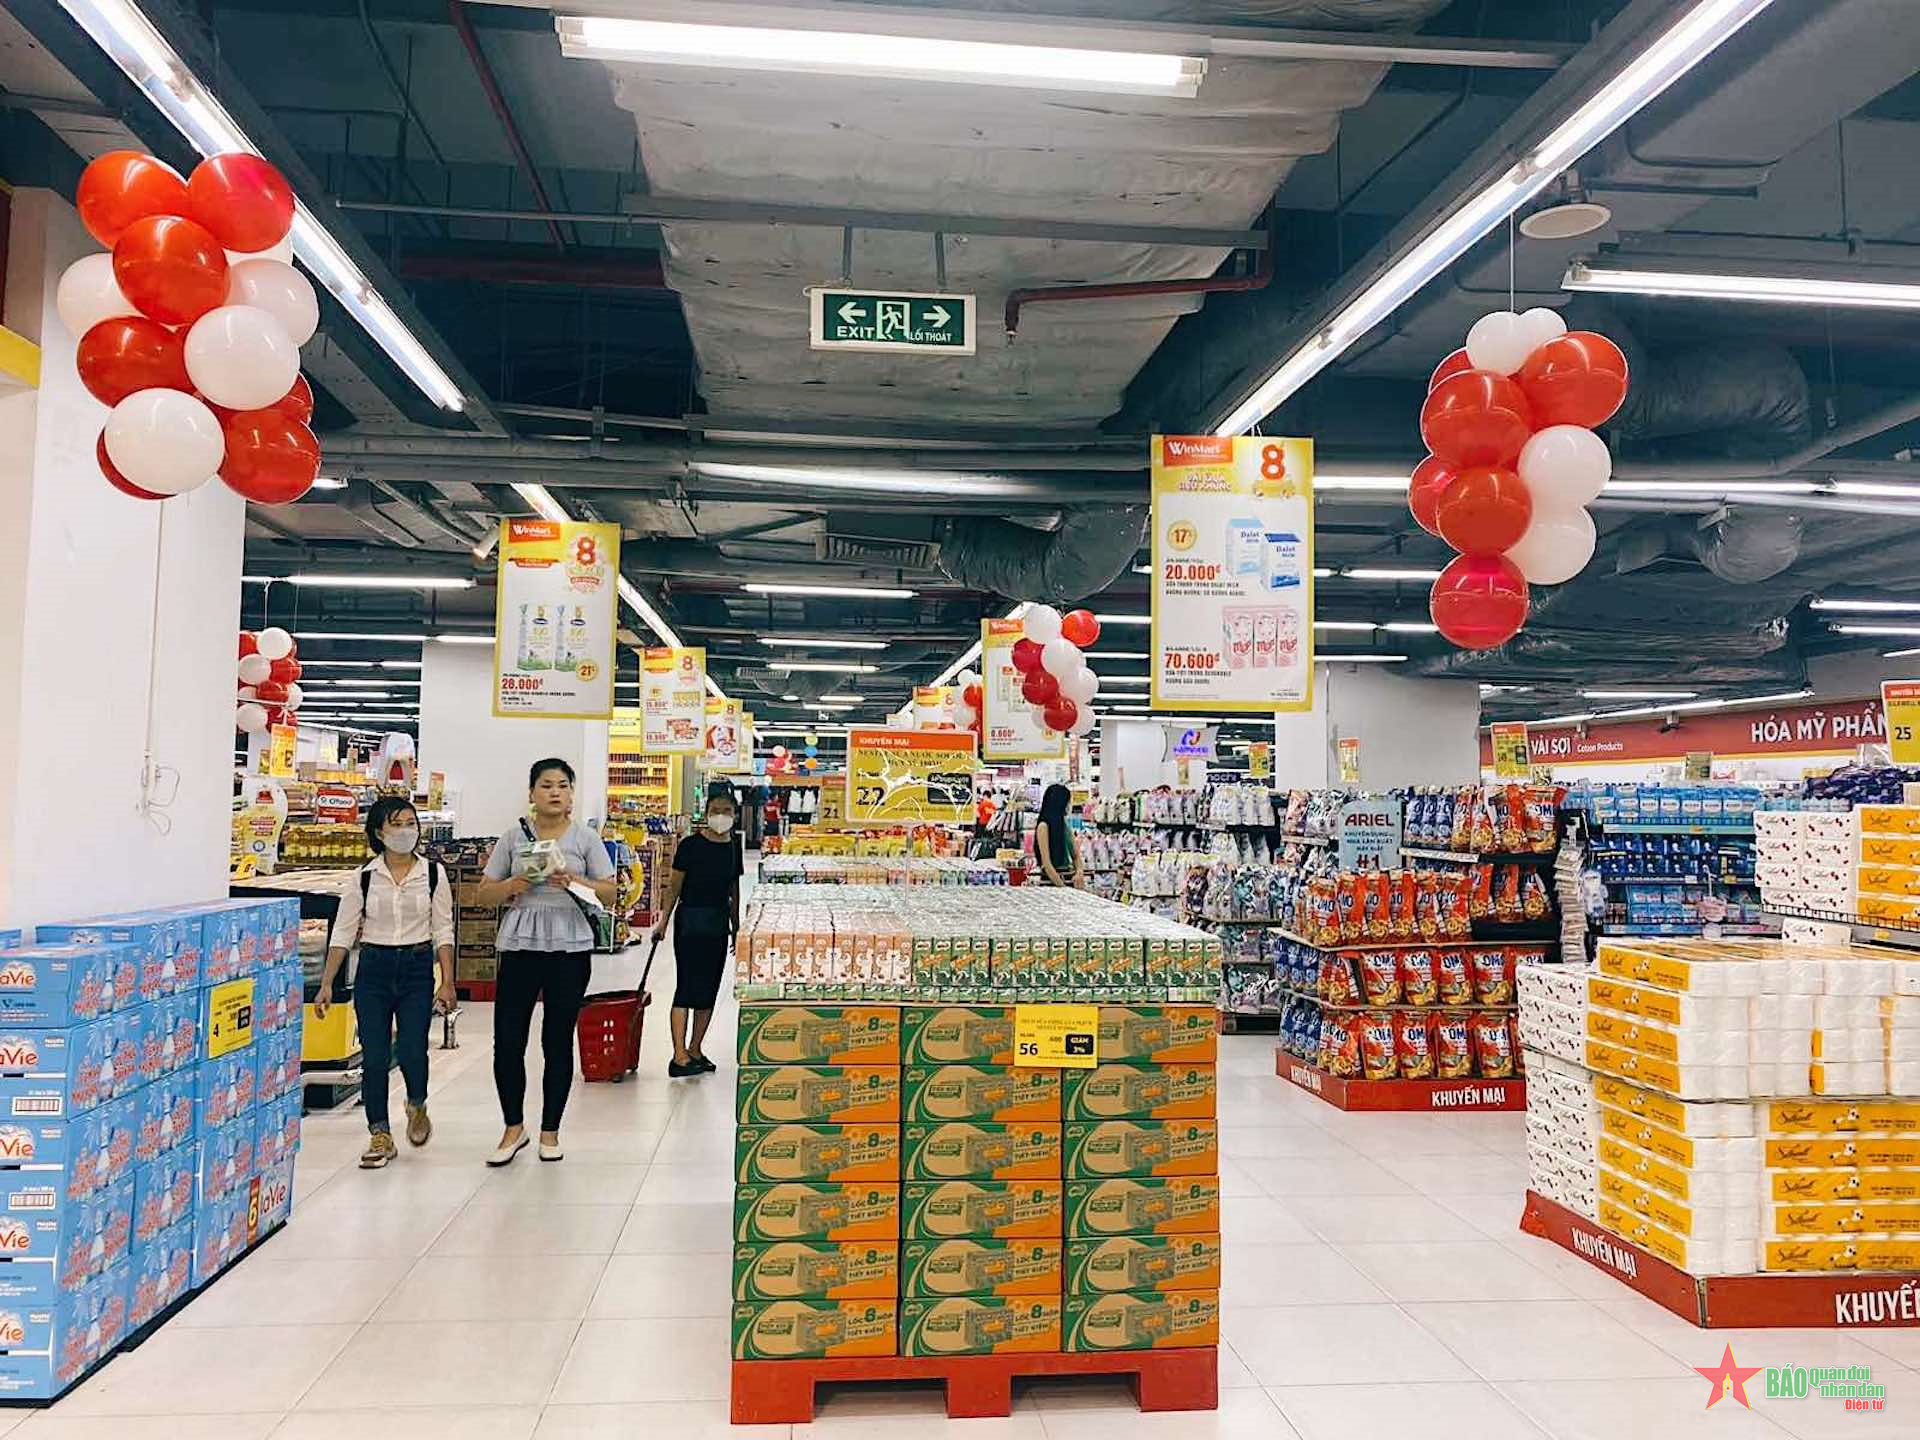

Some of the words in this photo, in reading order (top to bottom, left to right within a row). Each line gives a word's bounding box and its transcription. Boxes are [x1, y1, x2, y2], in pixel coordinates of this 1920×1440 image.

[837, 326, 875, 338] EXIT
[911, 328, 924, 341] LỐI
[926, 329, 952, 342] THOÁT
[1261, 444, 1285, 480] 8
[577, 536, 596, 566] 8
[682, 656, 693, 671] 8
[1751, 714, 1792, 743] HÓA
[1797, 710, 1827, 740] MỸ
[1895, 727, 1912, 740] 25
[1531, 734, 1549, 755] VẢI
[1551, 736, 1571, 758] SỢI
[1597, 741, 1624, 752] Products
[823, 808, 839, 819] 21
[1345, 813, 1395, 826] ARIEL
[1356, 854, 1380, 870] #1
[868, 1017, 880, 1031] 8
[1187, 1015, 1198, 1028] 8
[213, 1023, 219, 1038] 4
[1019, 1043, 1038, 1056] 56
[868, 1075, 880, 1088] 8
[1032, 1073, 1042, 1086] 8
[1187, 1071, 1198, 1084] 8
[1432, 1084, 1480, 1107] KHUYẾN
[1482, 1087, 1505, 1107] MẠI
[868, 1133, 880, 1147] 8
[1032, 1132, 1042, 1145] 8
[868, 1191, 879, 1205] 8
[1032, 1190, 1043, 1203] 8
[1192, 1243, 1202, 1256] 8
[1571, 1226, 1614, 1268] KHUYẾN
[1614, 1247, 1638, 1280] MẠI
[866, 1250, 877, 1264] 8
[1031, 1305, 1042, 1318] 8
[1189, 1299, 1199, 1313] 8
